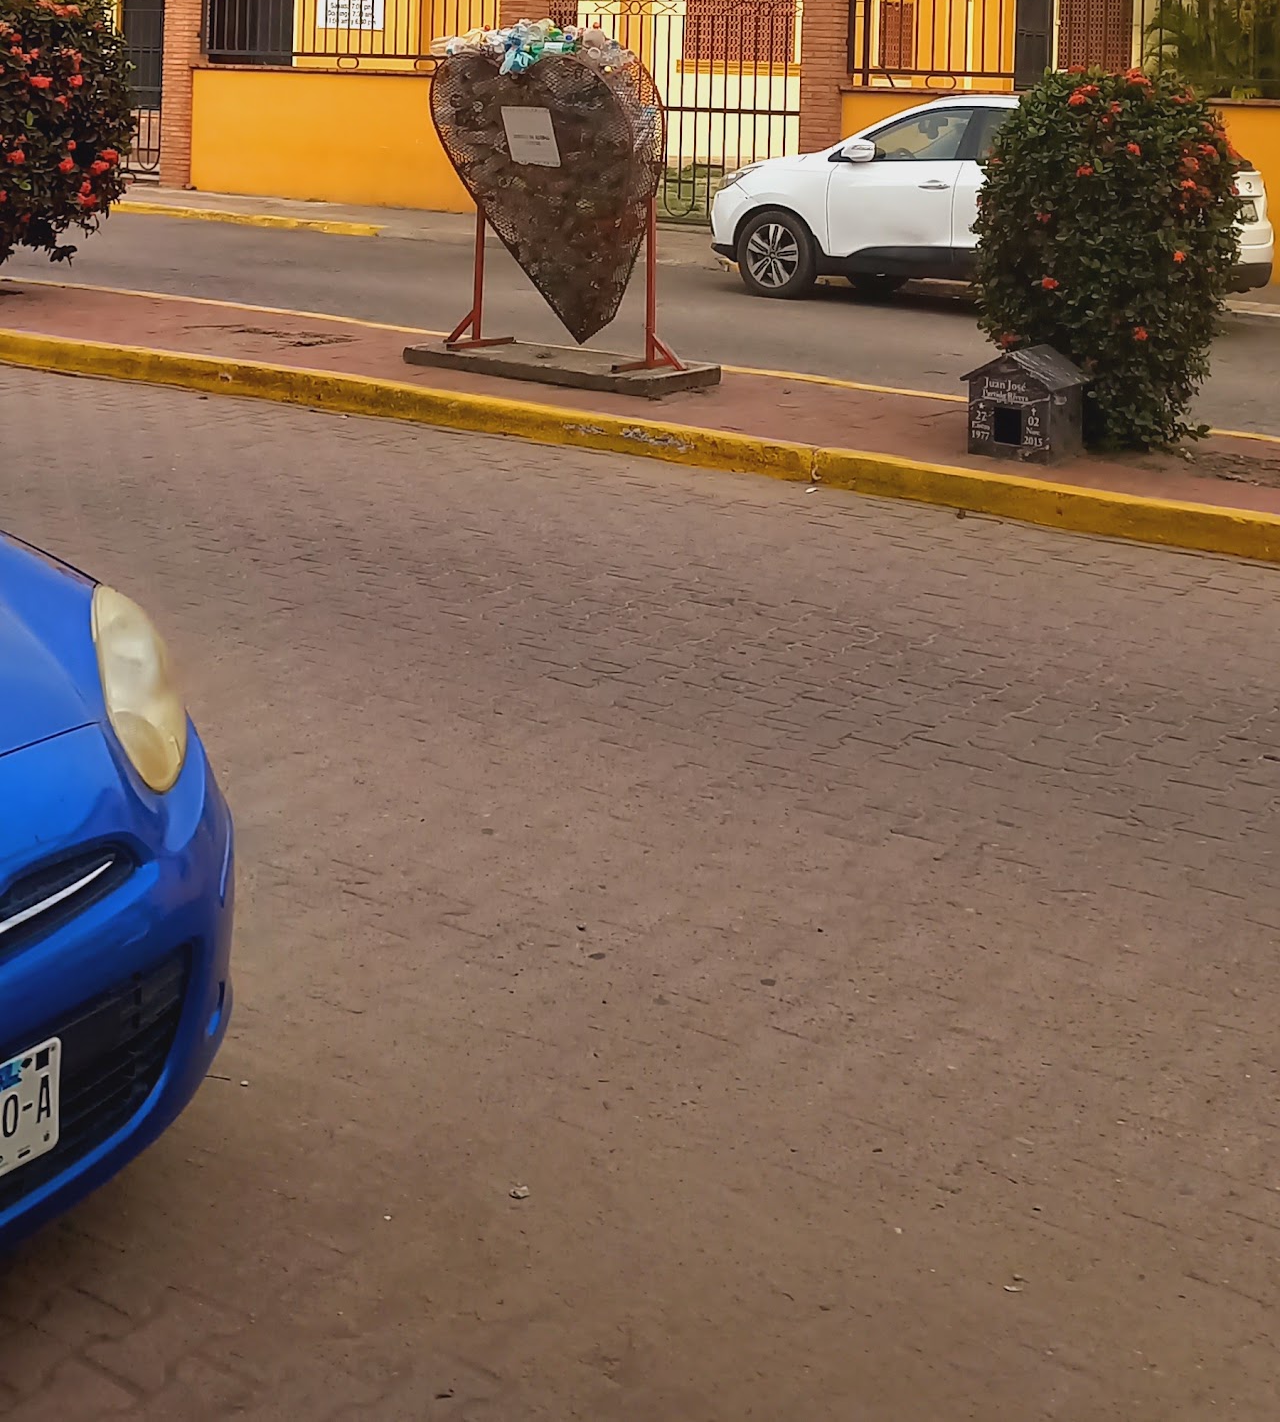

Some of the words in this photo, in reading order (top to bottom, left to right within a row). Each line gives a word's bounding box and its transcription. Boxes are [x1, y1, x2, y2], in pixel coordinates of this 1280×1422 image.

[984, 377, 1005, 389] Juan
[1006, 380, 1026, 392] José
[975, 410, 988, 422] 22
[1027, 415, 1040, 427] 02
[971, 429, 990, 441] 1977
[1023, 435, 1043, 447] 2015
